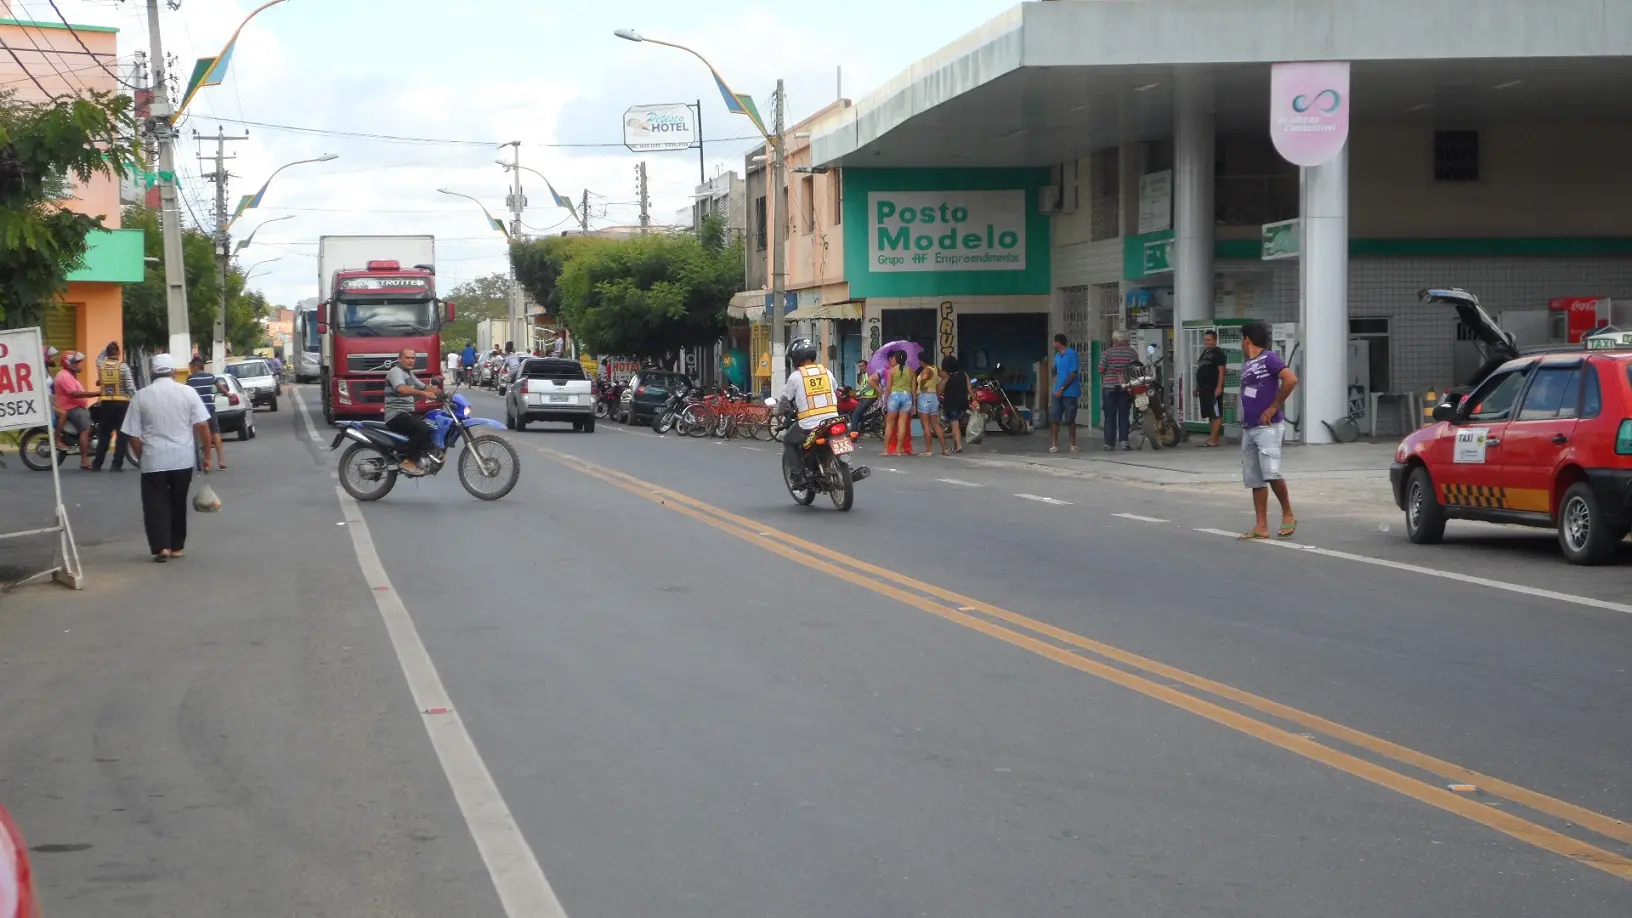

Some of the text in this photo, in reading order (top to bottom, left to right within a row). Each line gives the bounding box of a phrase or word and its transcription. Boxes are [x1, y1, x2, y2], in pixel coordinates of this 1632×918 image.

[652, 122, 689, 132] HOTEL
[877, 201, 968, 224] Posto
[877, 224, 1018, 250] Modelo
[878, 254, 904, 266] Grupo
[935, 252, 1019, 265] Empreendimentos
[1590, 339, 1613, 349] TAXI
[809, 377, 823, 387] 87
[1458, 433, 1474, 443] TAXI
